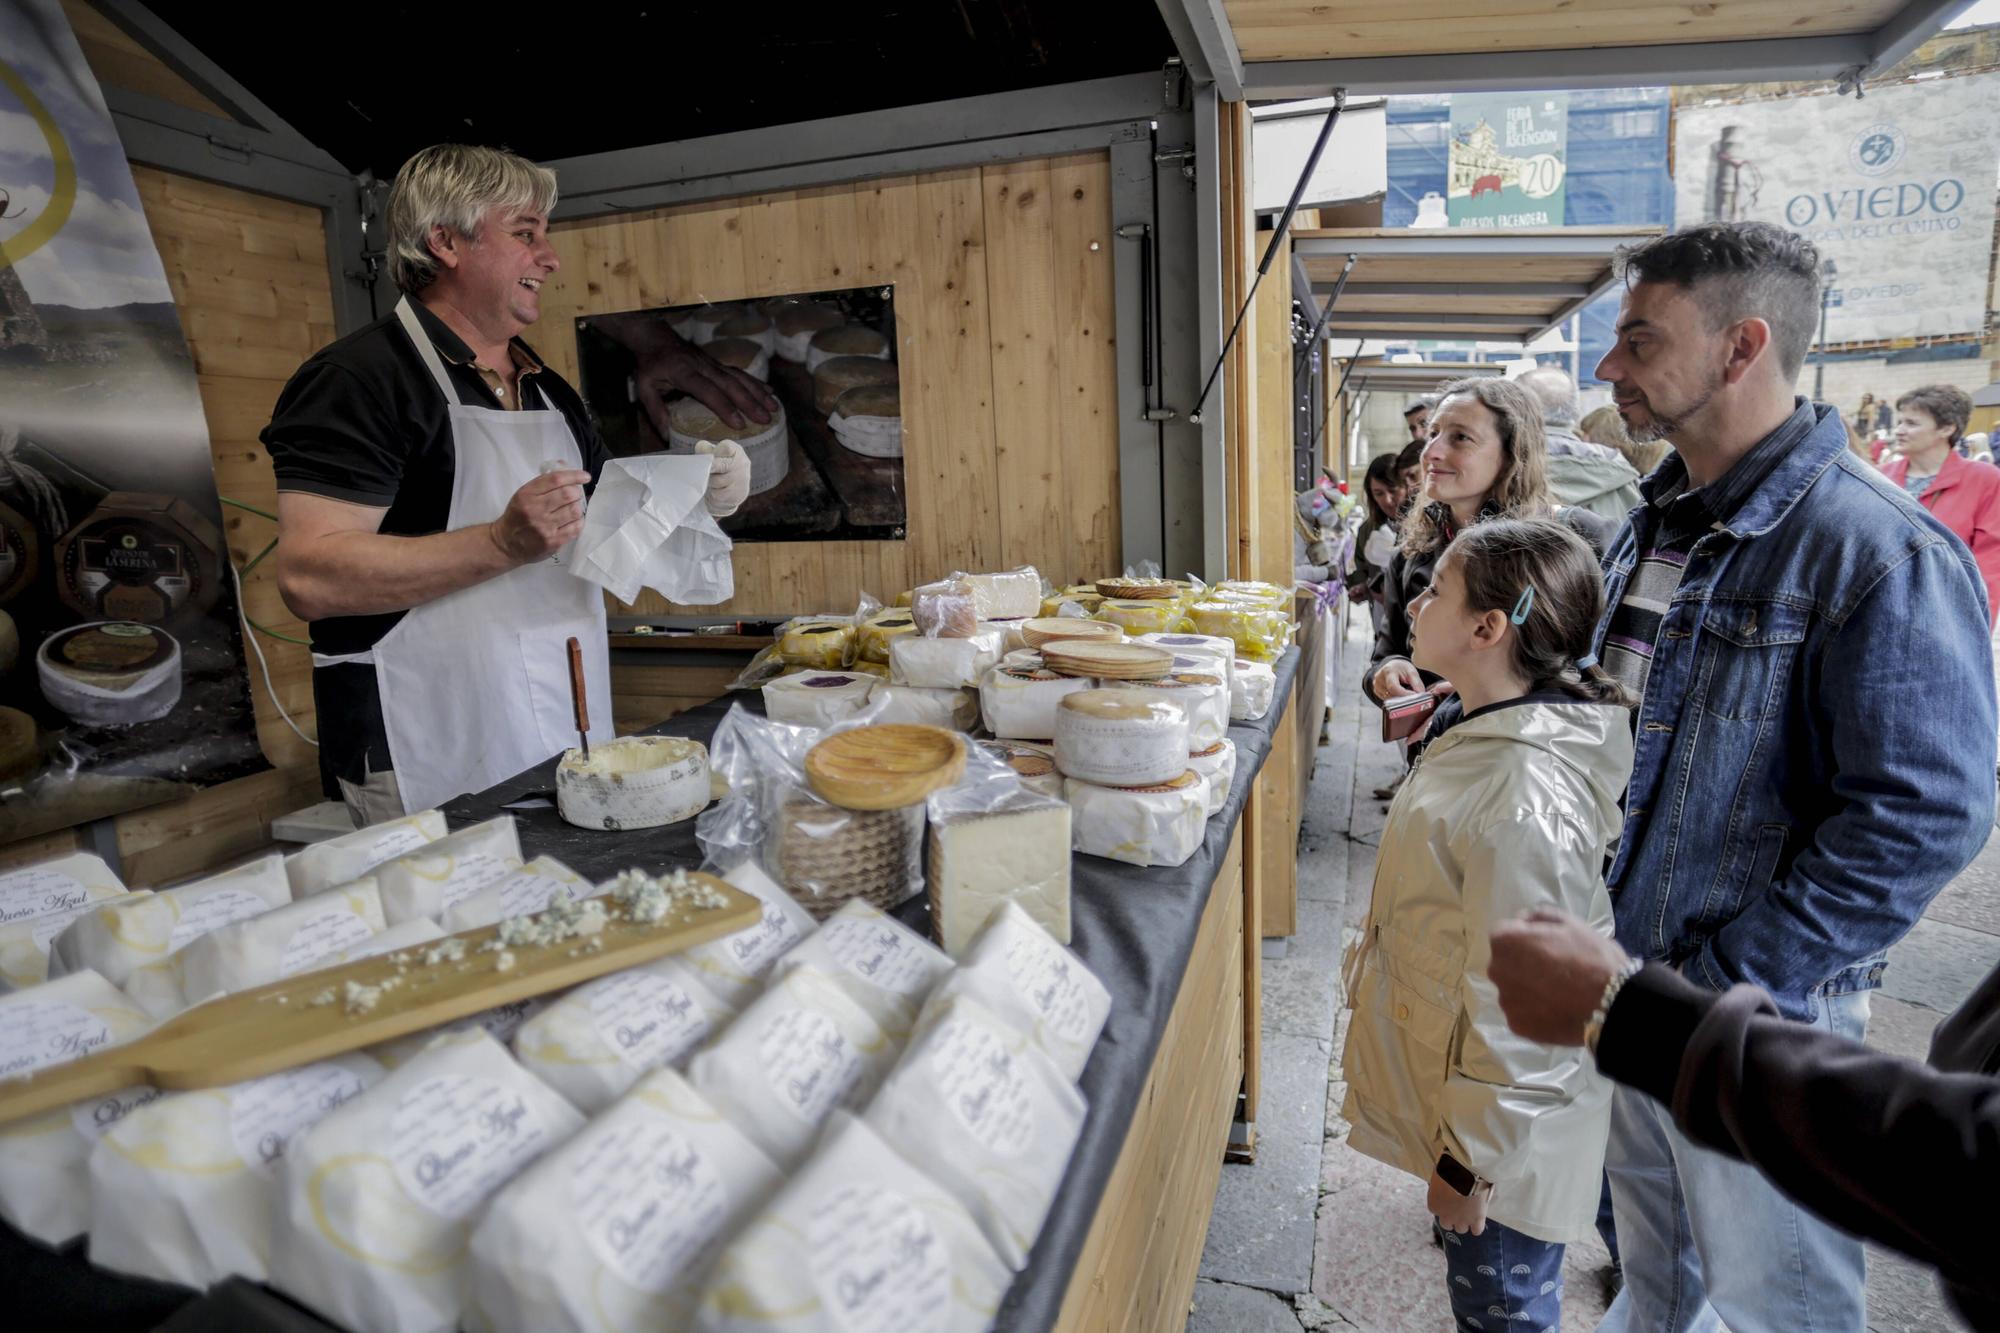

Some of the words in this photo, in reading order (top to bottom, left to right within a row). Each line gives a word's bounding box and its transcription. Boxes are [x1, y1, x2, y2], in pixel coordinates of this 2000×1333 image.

[1506, 105, 1532, 120] FERIA
[1525, 158, 1555, 194] 20
[1786, 179, 1965, 228] OVIEDO
[1852, 224, 1883, 240] DEL
[1887, 216, 1961, 236] CAMINO
[1850, 283, 1919, 301] OVIEDO
[41, 890, 87, 911] Azul
